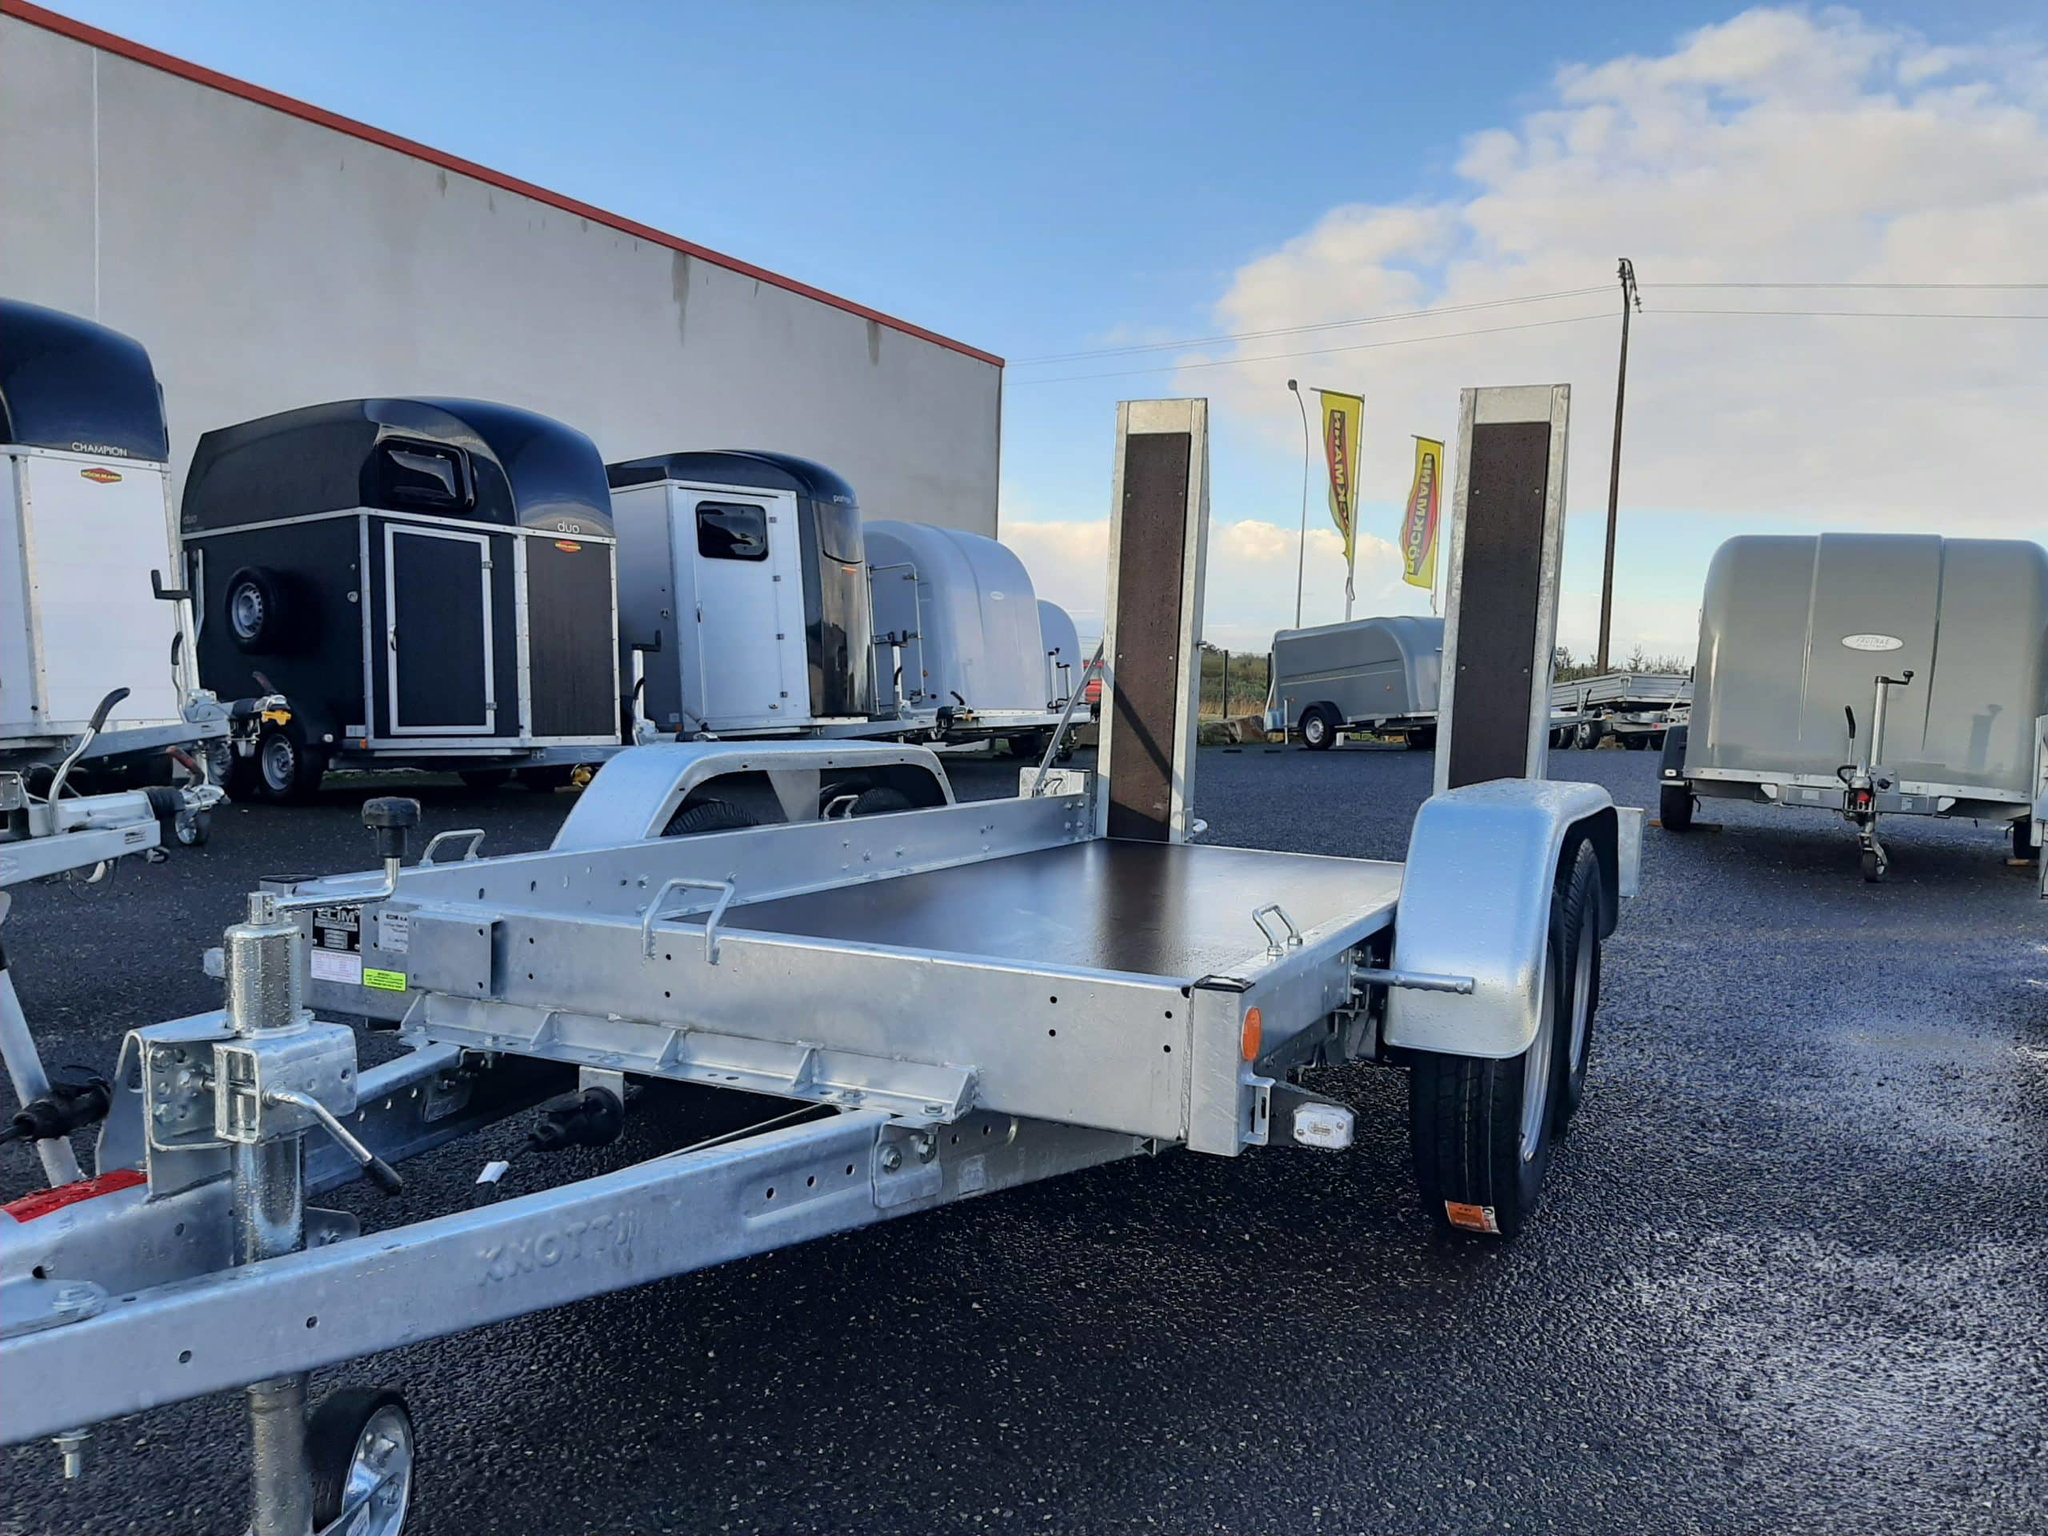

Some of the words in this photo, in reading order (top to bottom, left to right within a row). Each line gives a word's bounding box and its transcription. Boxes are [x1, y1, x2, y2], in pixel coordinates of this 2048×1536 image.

[71, 441, 128, 457] CHAMPION
[557, 520, 580, 534] duo
[475, 1214, 613, 1287] KNOTT
